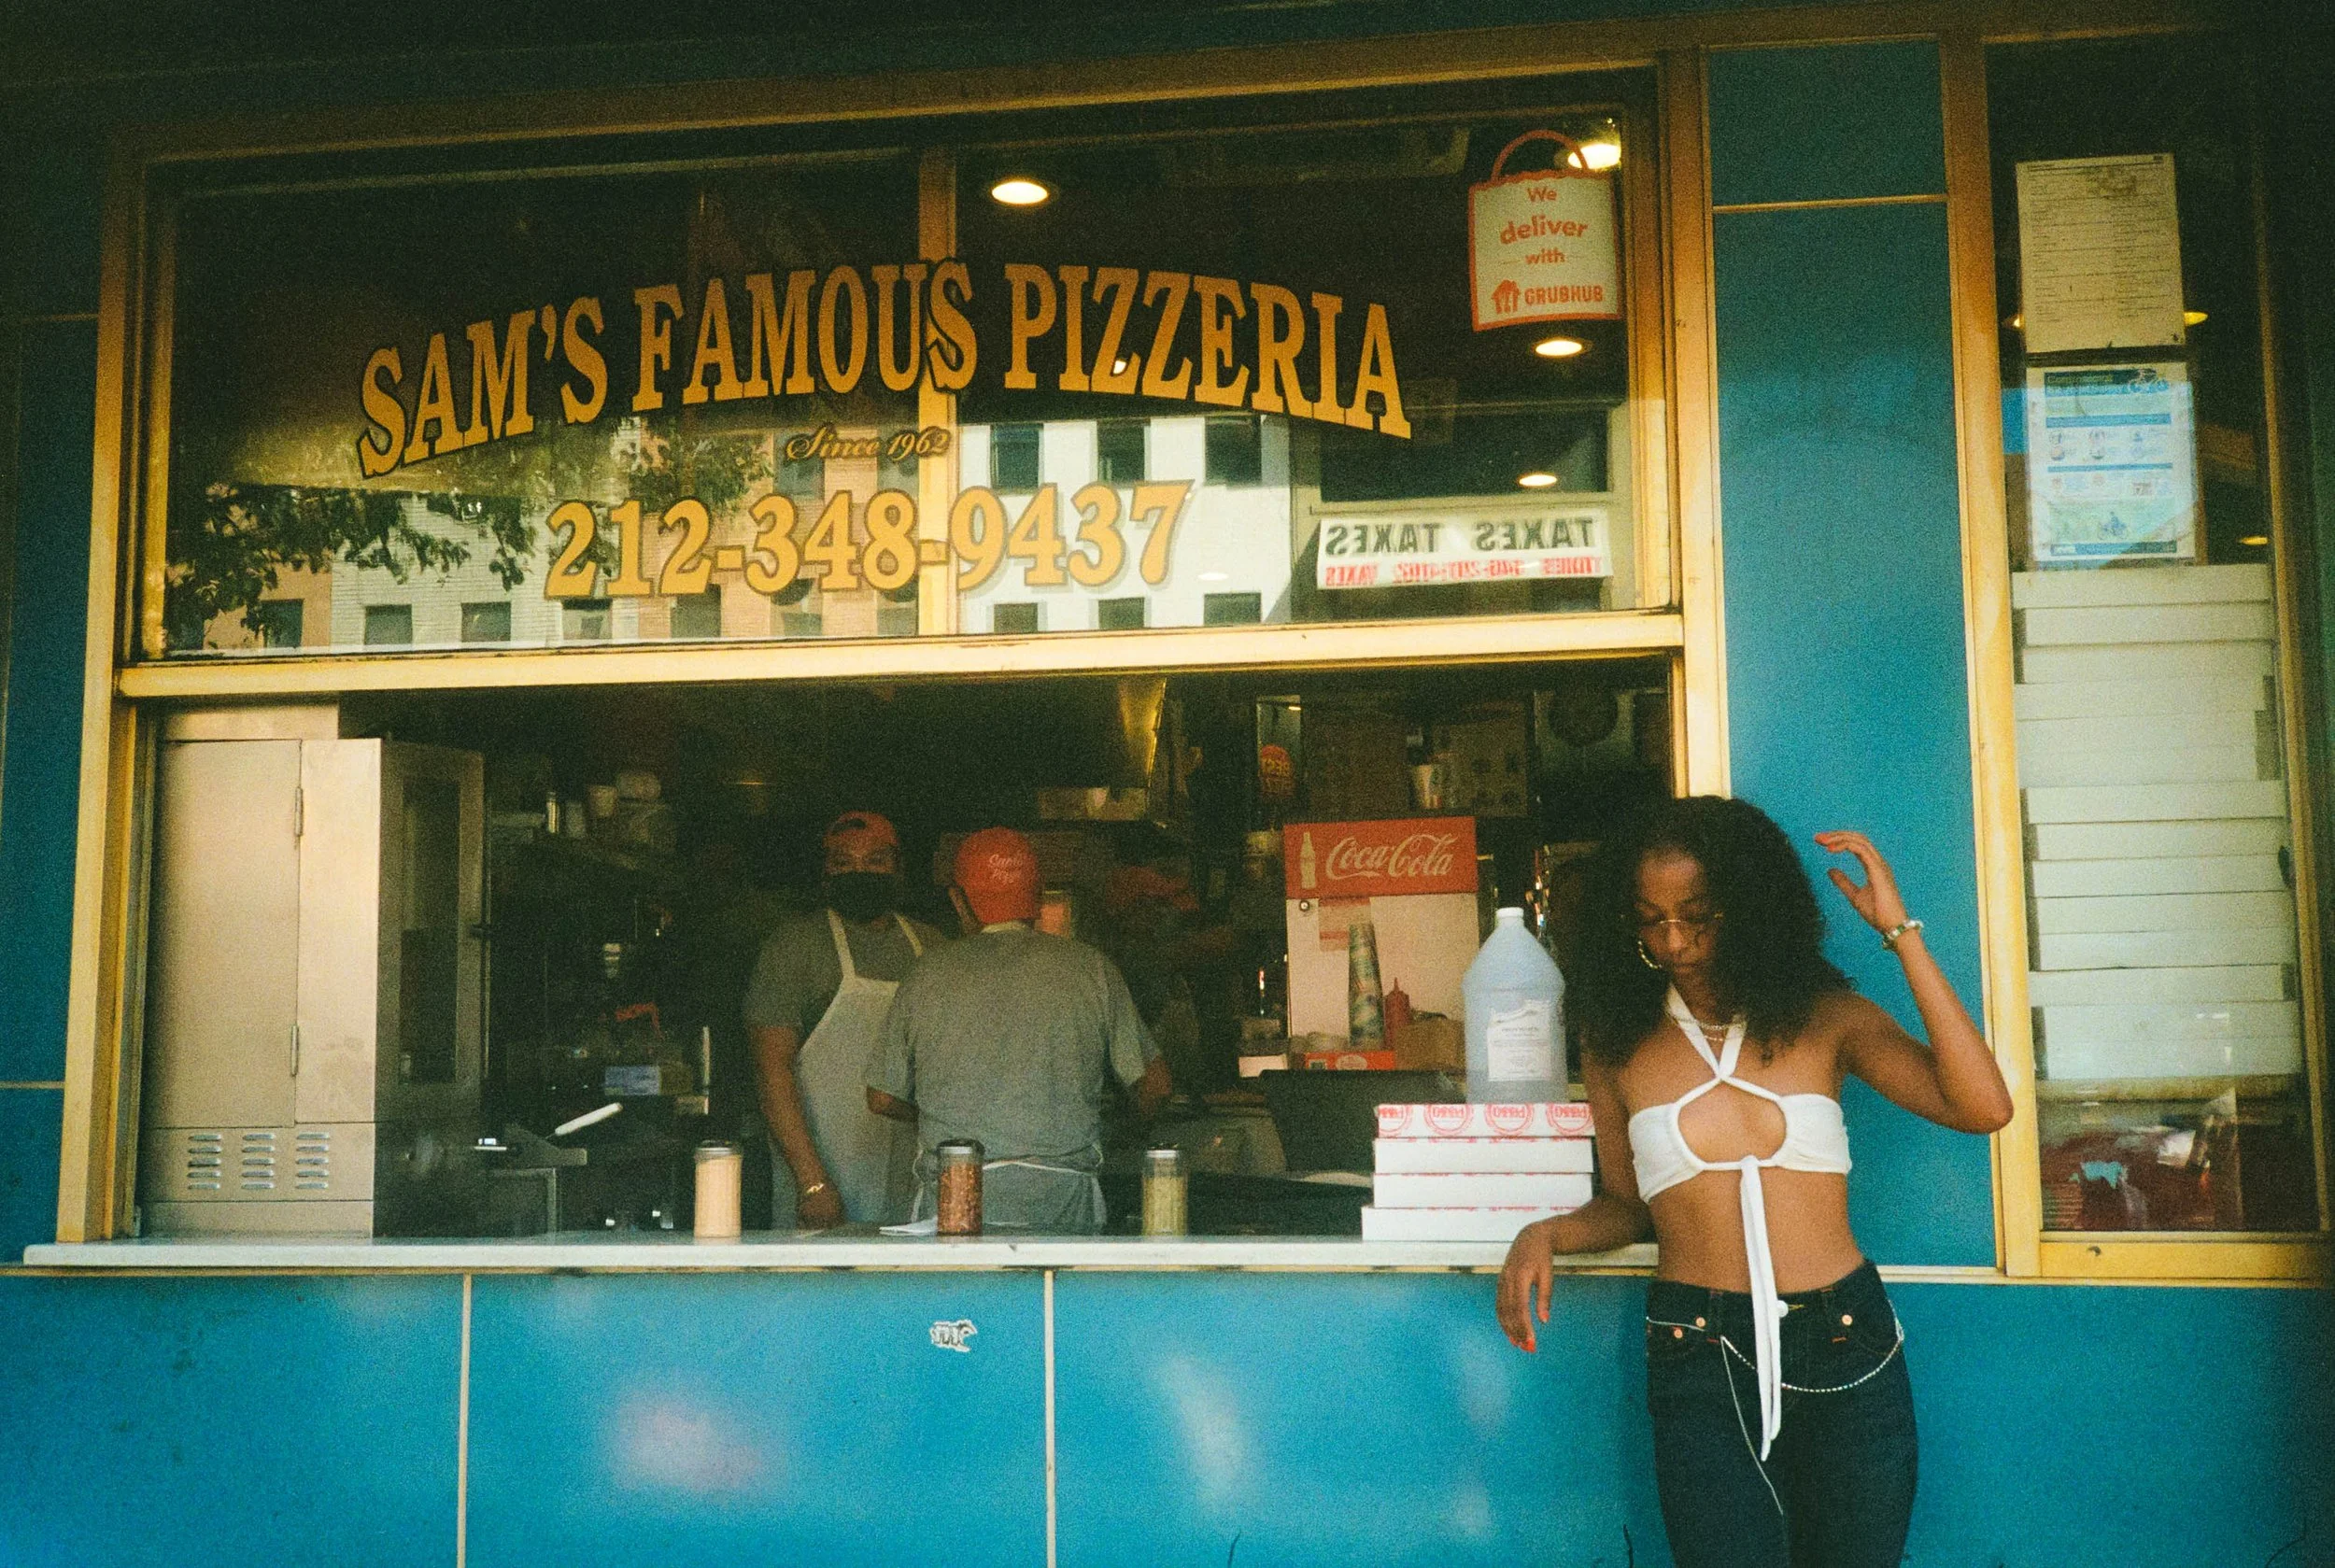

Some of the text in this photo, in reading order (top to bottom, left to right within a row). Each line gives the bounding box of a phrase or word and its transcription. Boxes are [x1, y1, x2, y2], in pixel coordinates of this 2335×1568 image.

[1527, 187, 1557, 202] We
[1500, 215, 1588, 245] deliver
[1525, 247, 1566, 265] with
[1524, 285, 1603, 305] GRUBHUB
[358, 259, 1411, 479] SAM'S FAMOUS PIZZERIA
[785, 422, 952, 462] Since 1962
[545, 480, 1194, 597] 212-348-9437
